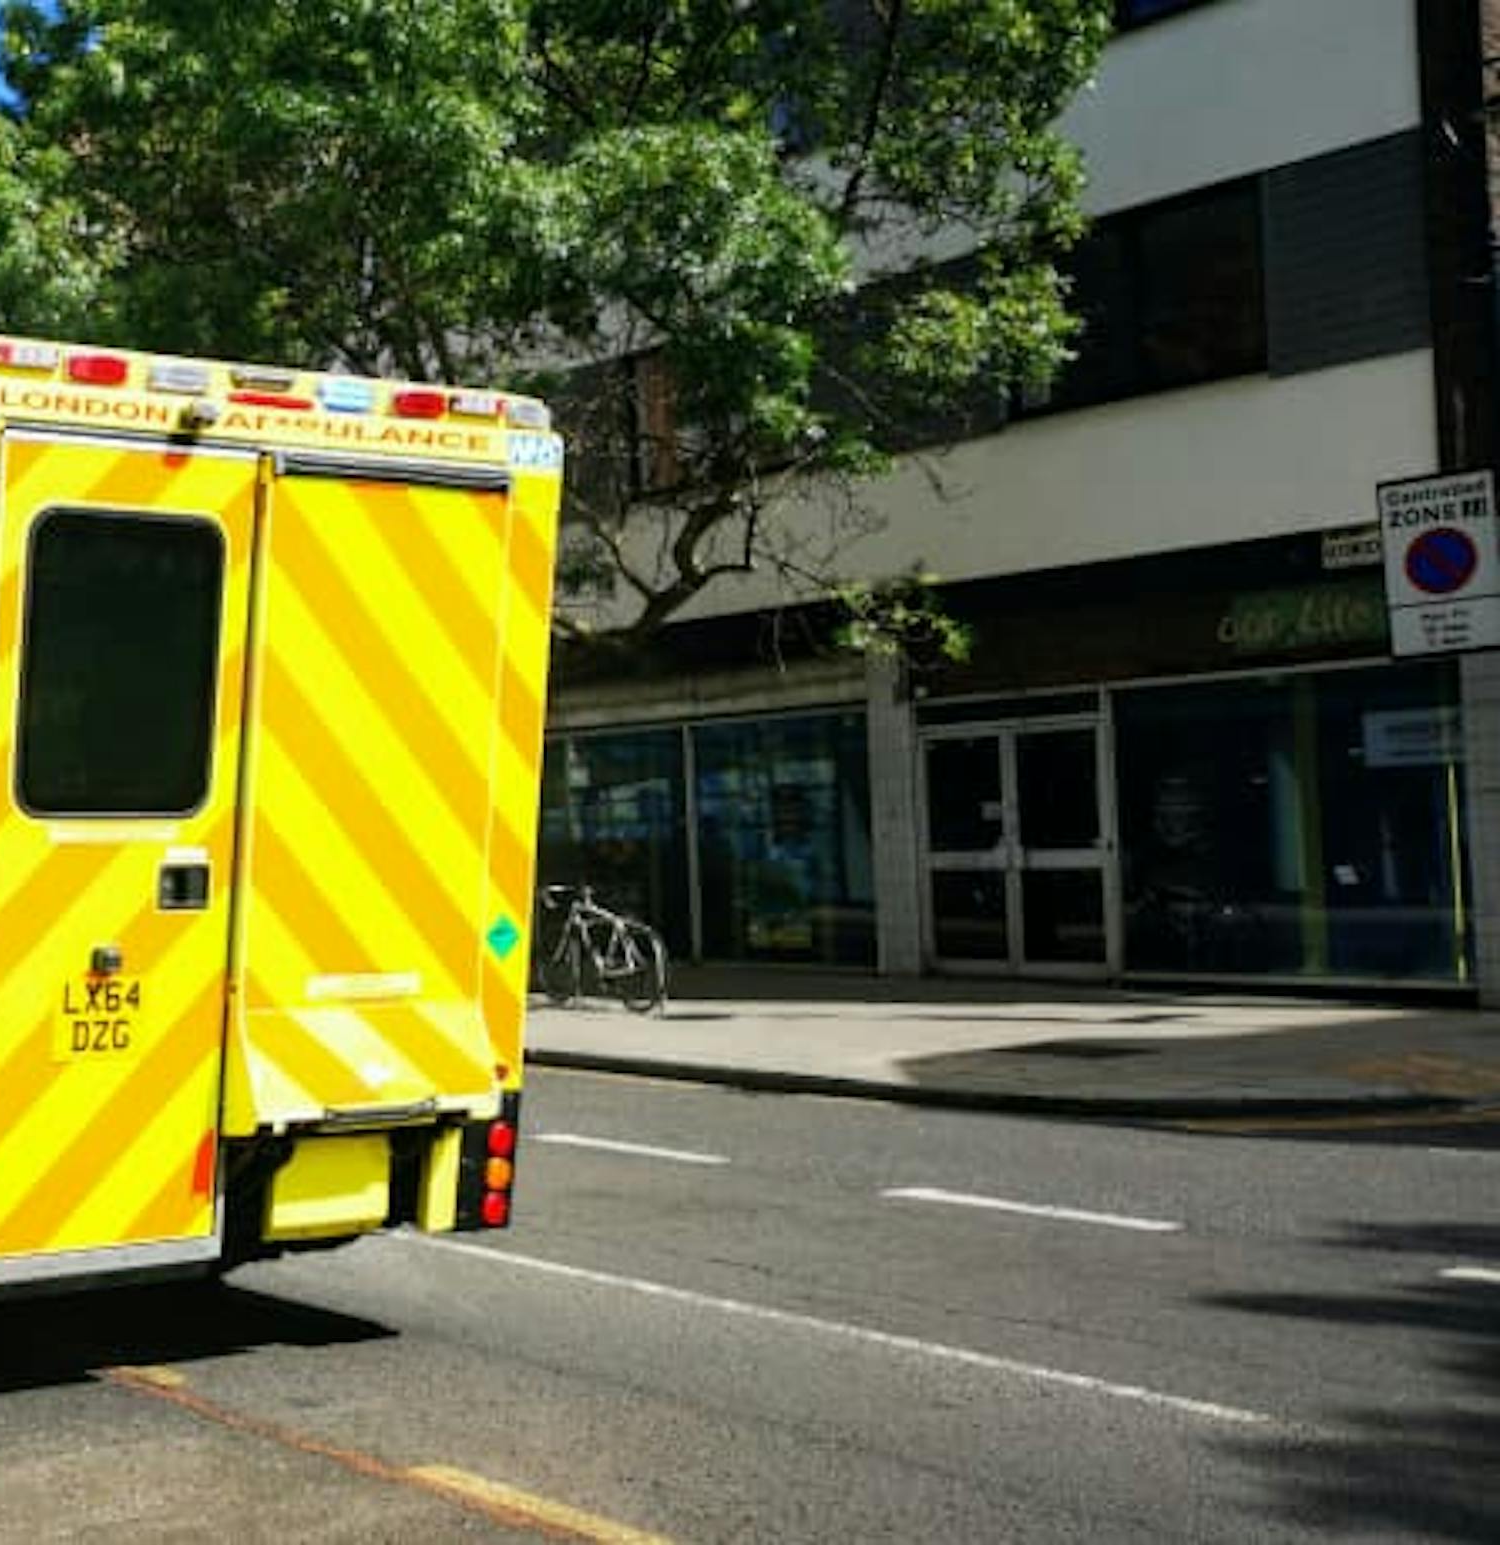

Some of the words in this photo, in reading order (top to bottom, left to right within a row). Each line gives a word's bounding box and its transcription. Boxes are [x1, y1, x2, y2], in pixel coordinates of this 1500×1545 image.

[0, 386, 169, 423] LONDON
[1388, 503, 1457, 527] ZONE
[63, 980, 141, 1015] LX64
[71, 1020, 131, 1052] DZG
